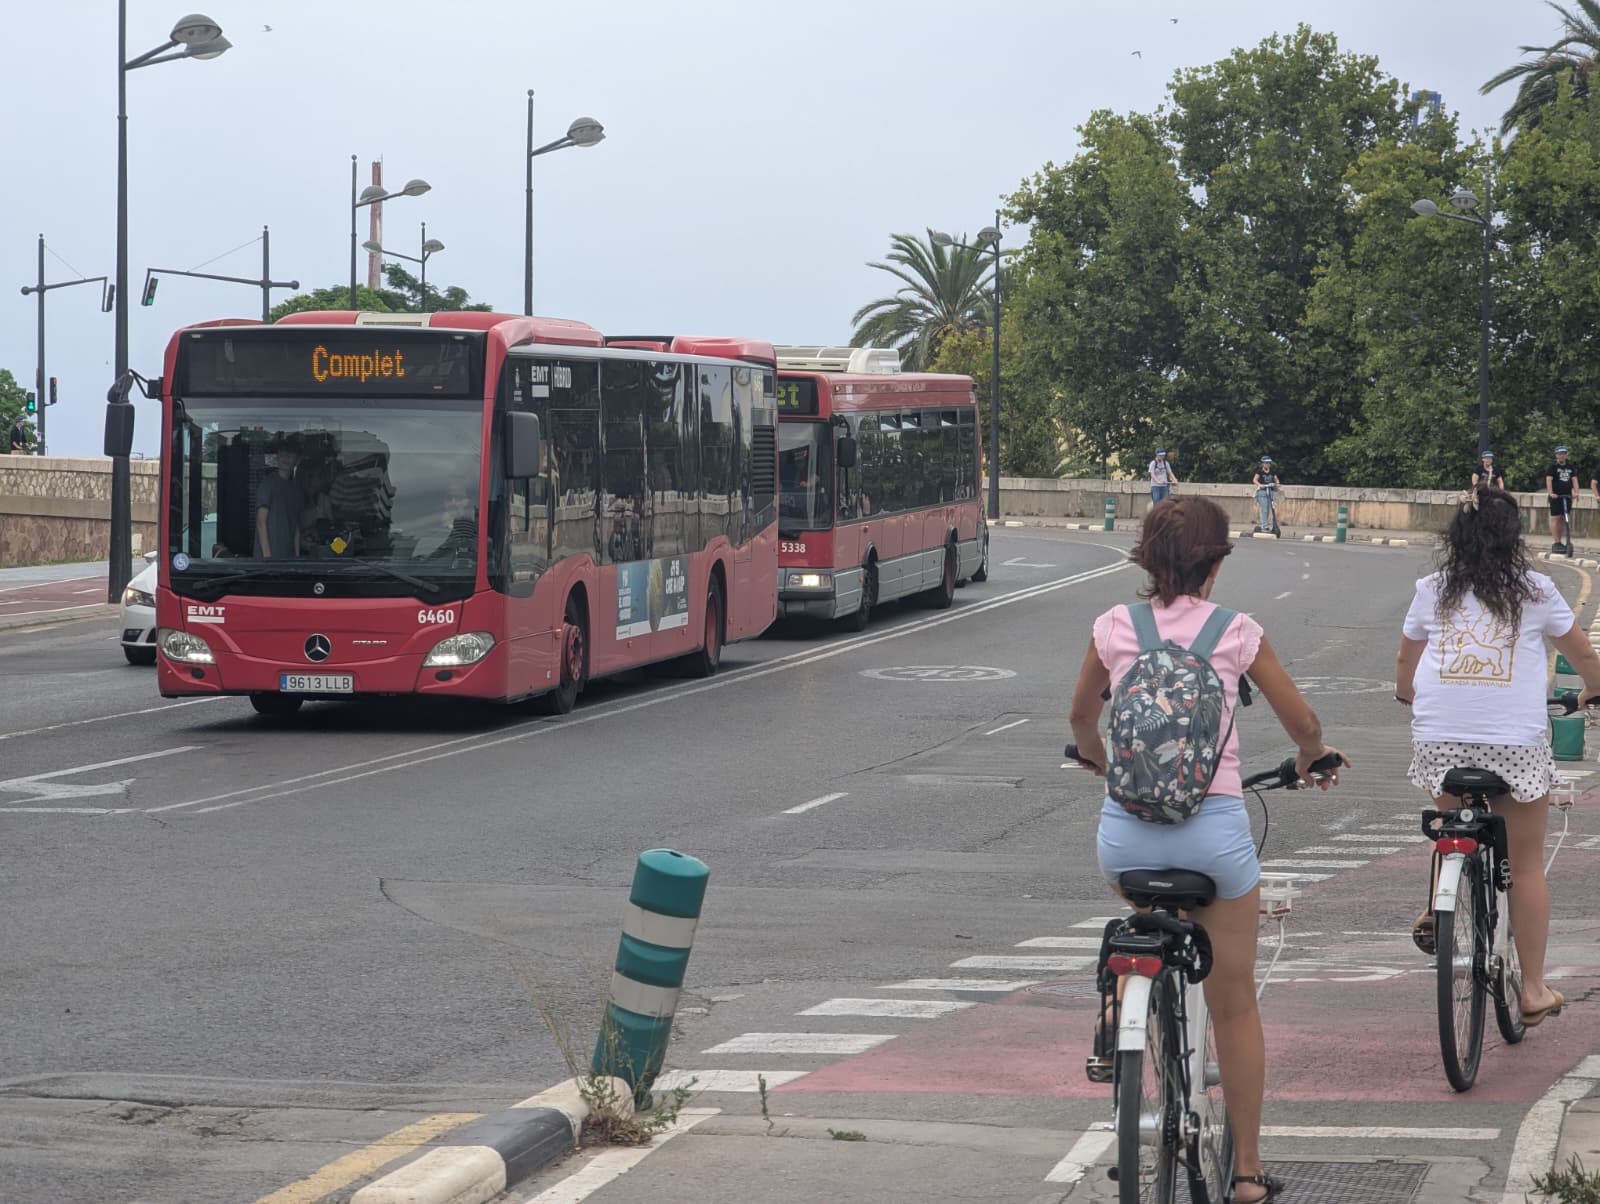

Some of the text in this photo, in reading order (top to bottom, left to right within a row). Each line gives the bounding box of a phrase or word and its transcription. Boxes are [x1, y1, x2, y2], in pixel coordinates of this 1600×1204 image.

[312, 345, 405, 382] Complet
[531, 366, 549, 383] EMT
[781, 542, 806, 553] 5338
[187, 606, 225, 616] EMT
[417, 609, 455, 624] 6460
[289, 676, 350, 690] 9613 LLB
